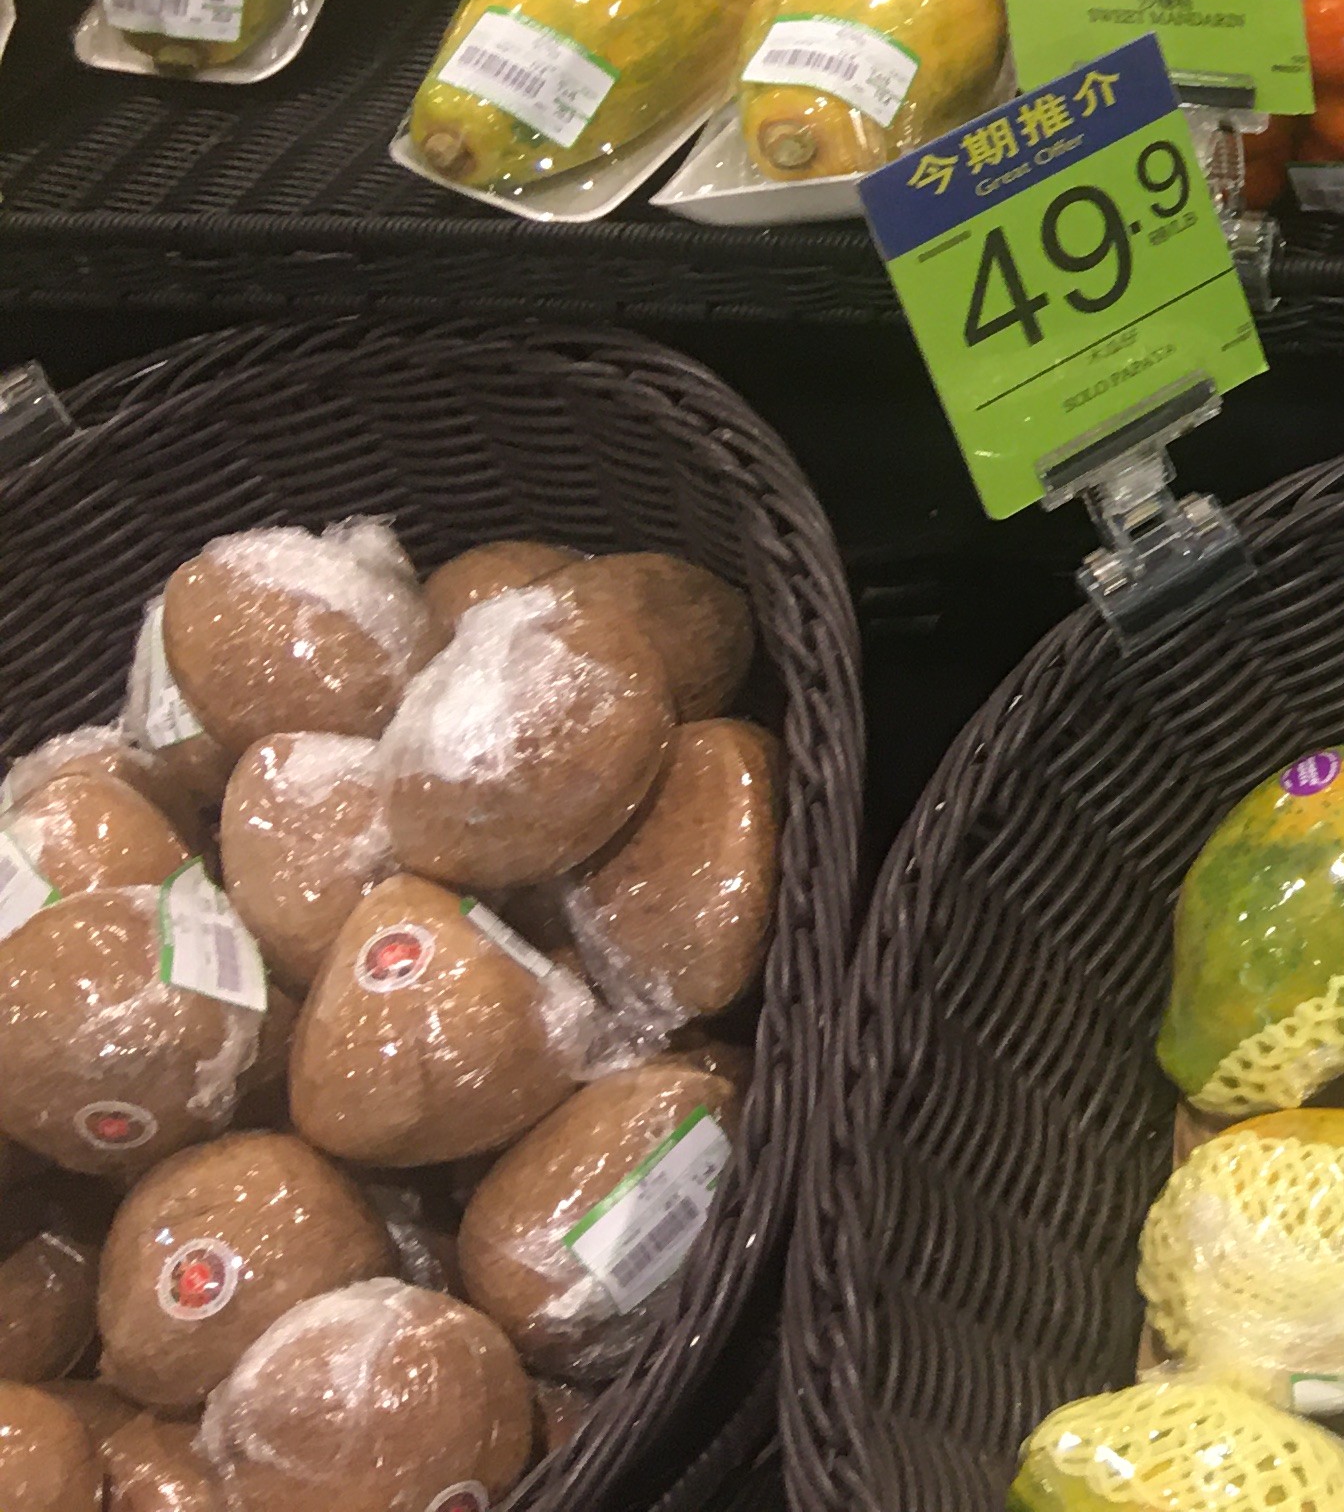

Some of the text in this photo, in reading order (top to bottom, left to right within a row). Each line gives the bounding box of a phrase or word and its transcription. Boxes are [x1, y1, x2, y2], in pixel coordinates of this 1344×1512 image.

[906, 70, 1121, 195] 今期推介
[975, 133, 1086, 199] Great Offer
[964, 139, 1191, 348] 49.9
